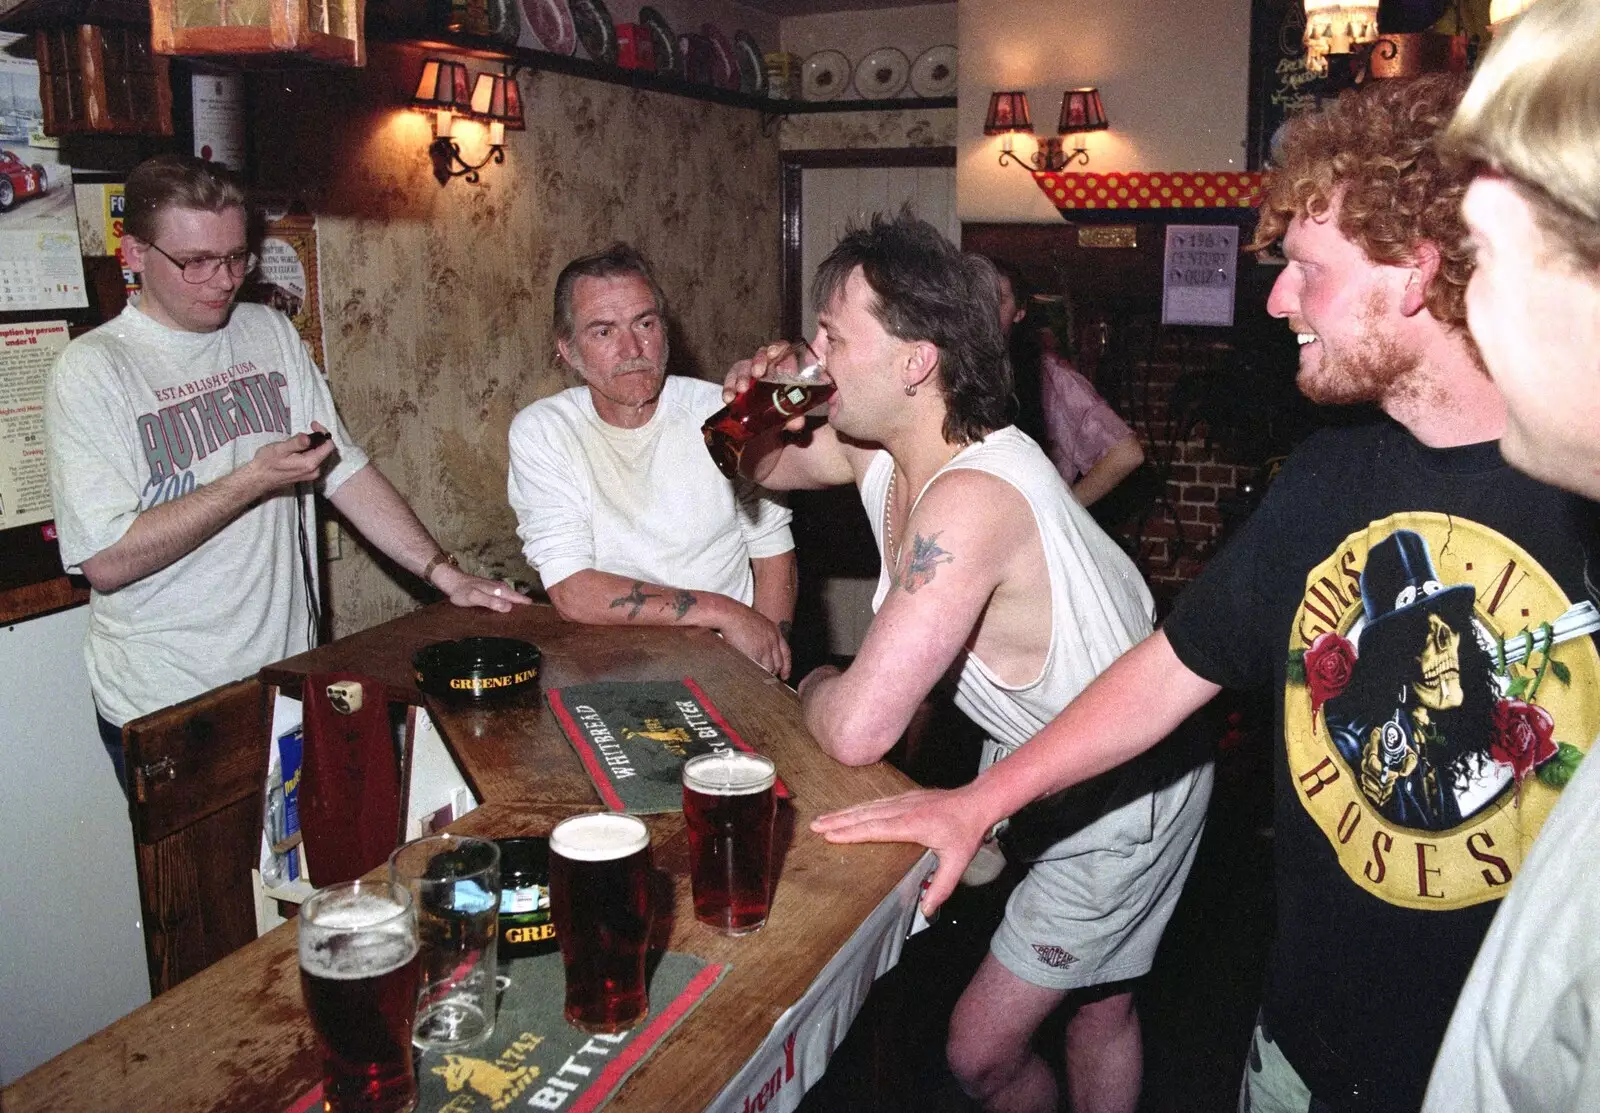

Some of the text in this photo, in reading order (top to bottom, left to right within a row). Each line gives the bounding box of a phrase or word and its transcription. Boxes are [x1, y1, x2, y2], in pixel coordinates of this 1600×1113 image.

[5, 336, 37, 346] under 18
[25, 327, 34, 336] by
[36, 326, 64, 335] persons
[234, 360, 257, 376] USA
[137, 371, 292, 487] AUTHENTIC
[1298, 547, 1364, 648] GUNS
[449, 675, 513, 690] GREENE
[675, 700, 718, 740] BITTER
[575, 704, 637, 780] WHITBREAD
[1299, 754, 1513, 899] ROSES
[505, 923, 557, 944] GRE
